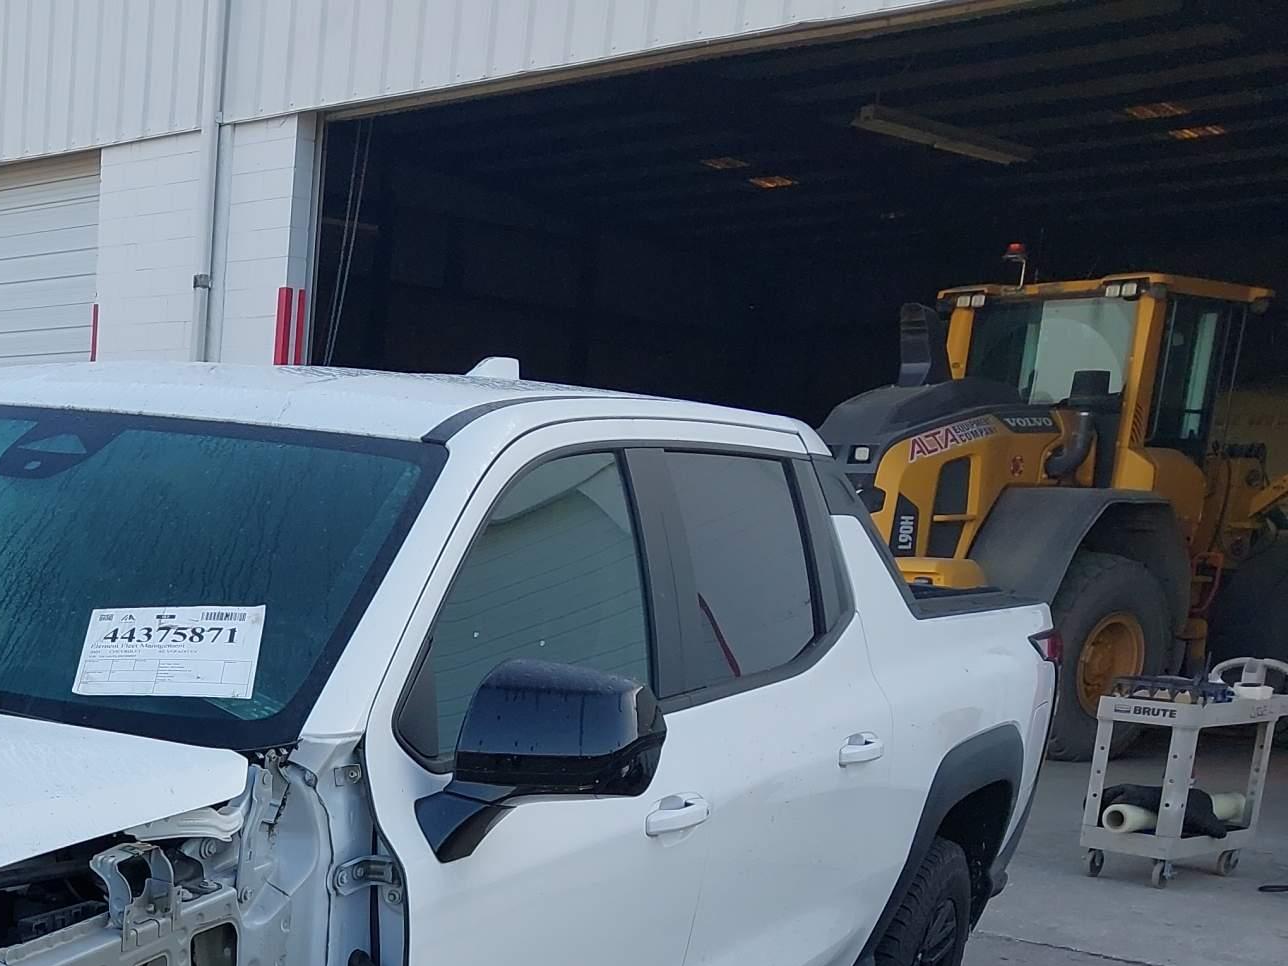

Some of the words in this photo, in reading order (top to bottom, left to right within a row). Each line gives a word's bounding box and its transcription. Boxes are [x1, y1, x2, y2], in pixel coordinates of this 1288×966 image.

[1004, 417, 1053, 427] VOLVO
[958, 426, 998, 443] COMPANY
[909, 428, 961, 462] ALTA
[897, 515, 915, 550] L90H
[103, 627, 238, 643] 44375871
[140, 643, 185, 651] Management
[1133, 705, 1177, 719] BRUTE
